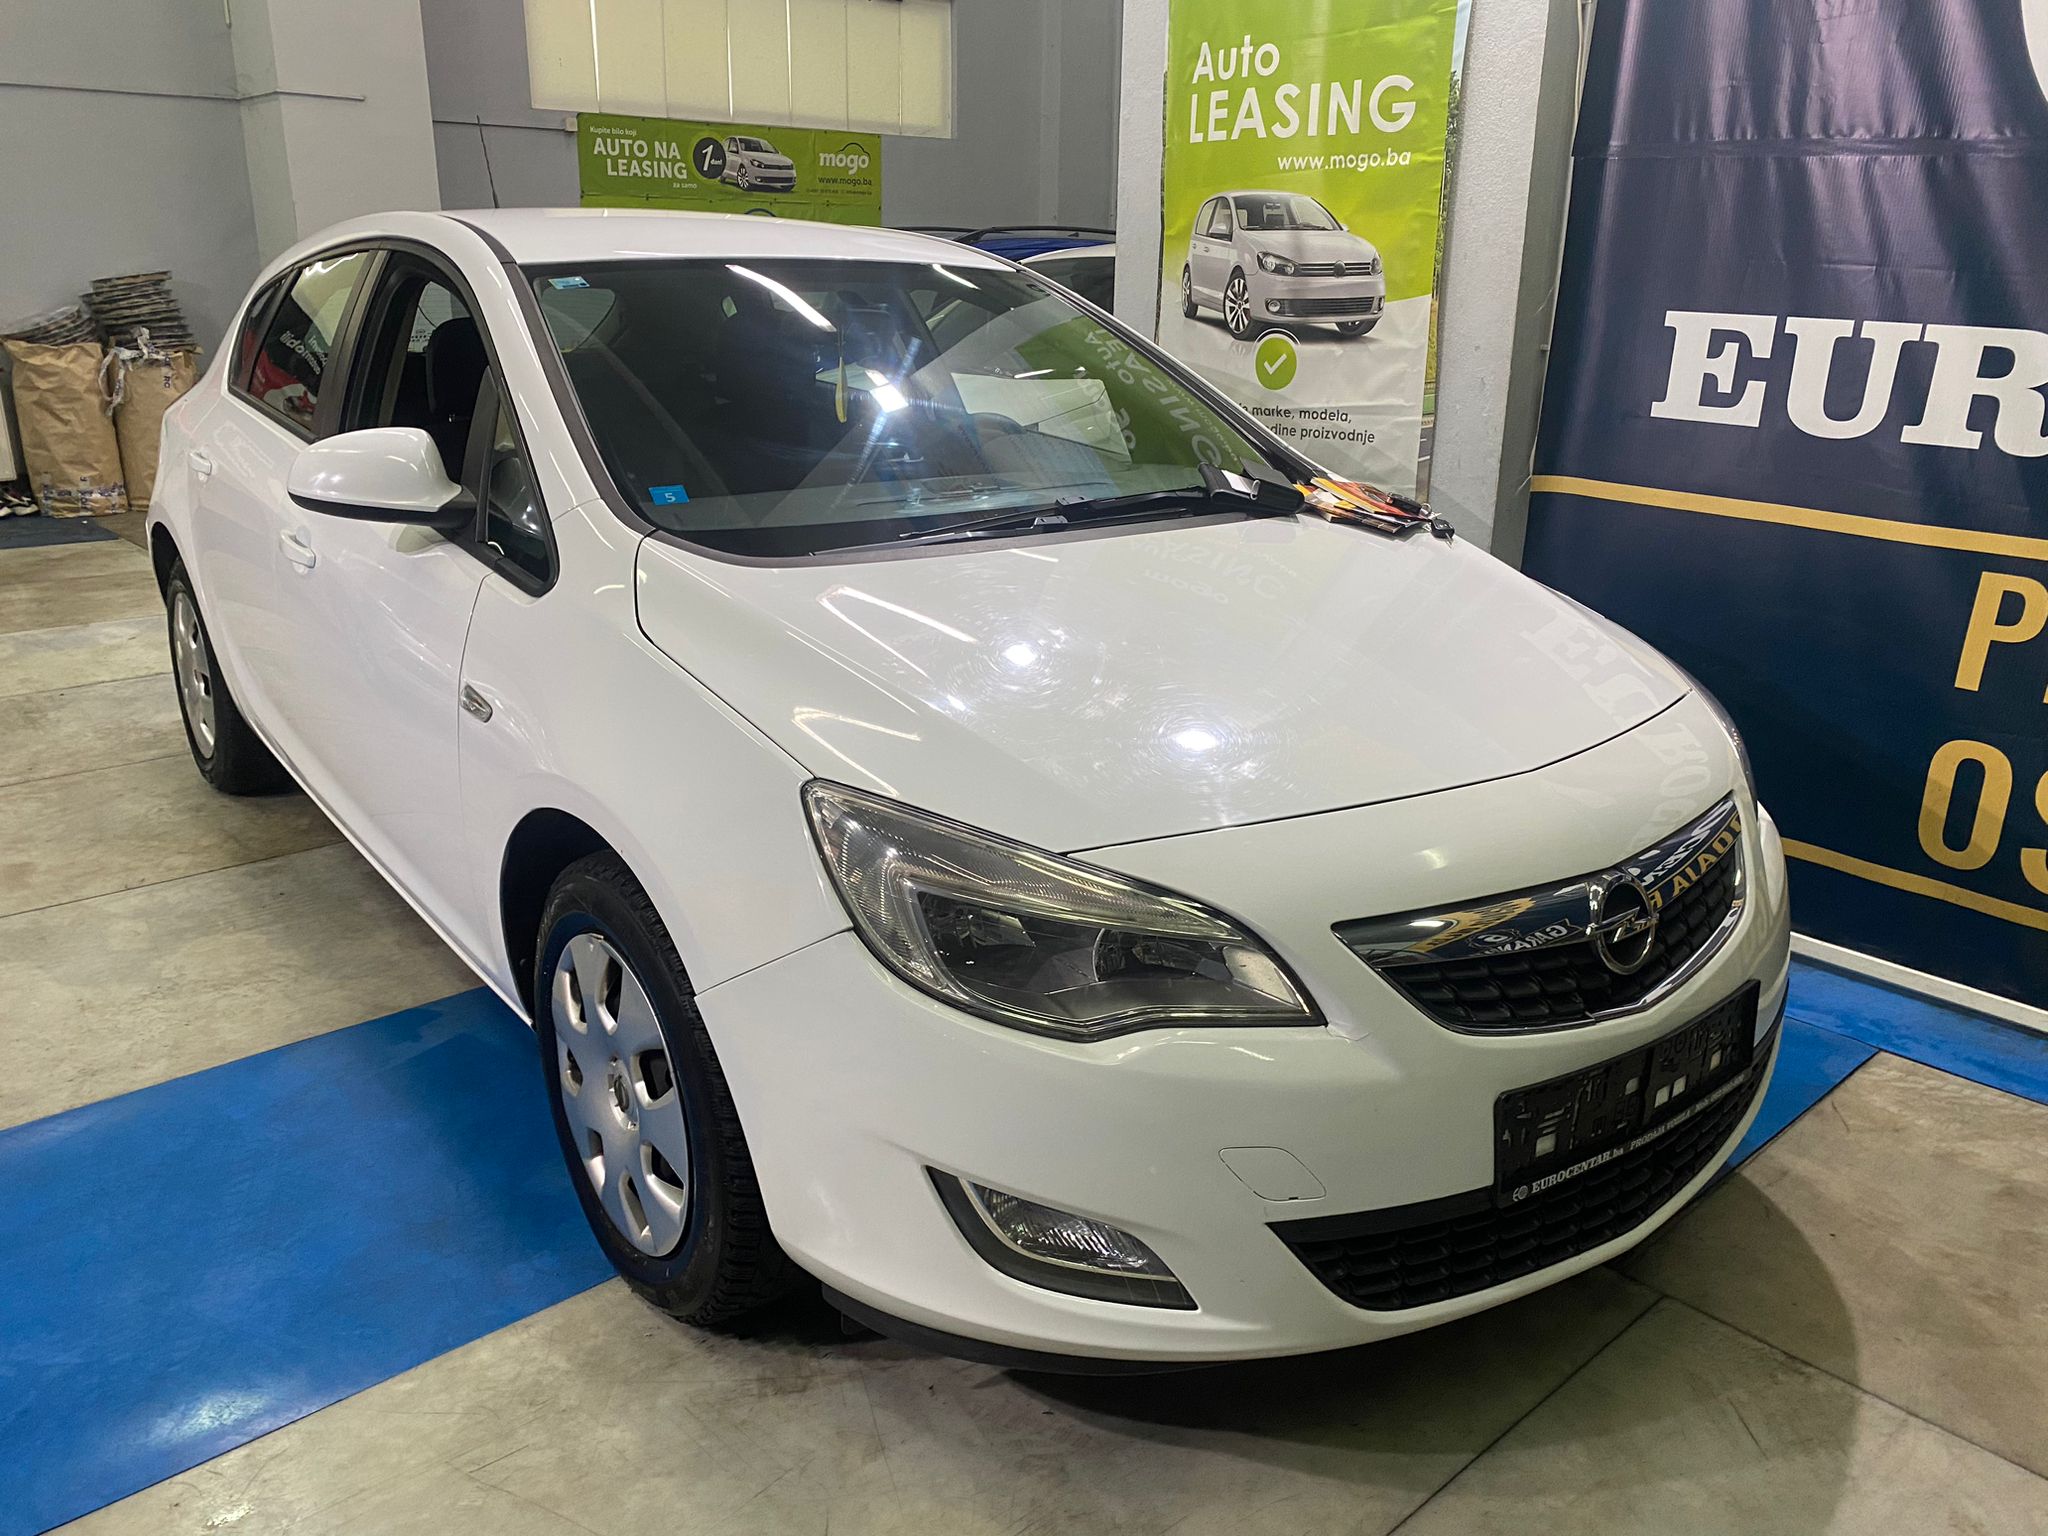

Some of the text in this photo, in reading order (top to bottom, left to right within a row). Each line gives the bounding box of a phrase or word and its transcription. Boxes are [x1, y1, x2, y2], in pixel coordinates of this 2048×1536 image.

[1192, 34, 1280, 84] Auto
[1189, 74, 1416, 144] LEASING
[611, 127, 624, 135] bilo
[625, 128, 637, 137] koji
[593, 137, 681, 160] AUTO NA
[701, 144, 714, 171] 1
[1277, 148, 1411, 172] www.mogo.ba
[607, 158, 688, 180] LEASING
[819, 152, 870, 175] mogo
[818, 176, 873, 187] www.mogo.ba
[1650, 310, 2048, 457] EUR
[1252, 405, 1295, 419] marke,
[1299, 408, 1352, 423] modela,
[1266, 424, 1375, 445] dine proizvodnje
[664, 492, 676, 503] 5
